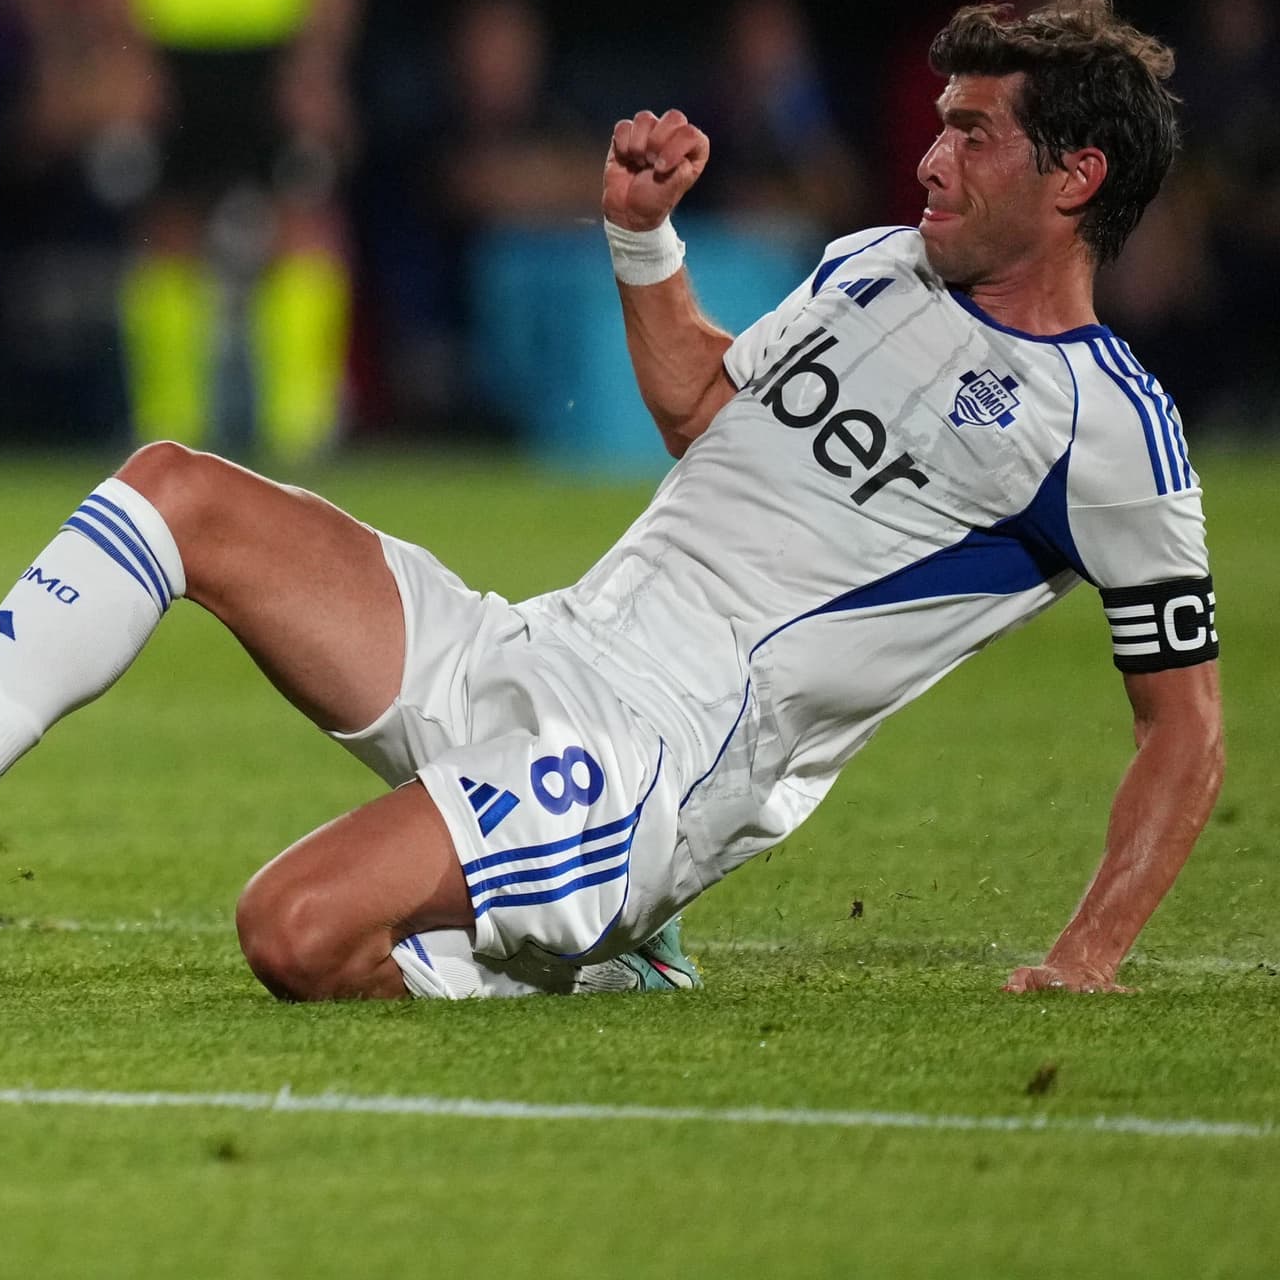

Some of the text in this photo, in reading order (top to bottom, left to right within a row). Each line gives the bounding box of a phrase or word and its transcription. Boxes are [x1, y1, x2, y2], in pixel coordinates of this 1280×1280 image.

[969, 380, 1005, 416] COMO
[1163, 594, 1207, 651] C
[530, 746, 604, 816] 8
